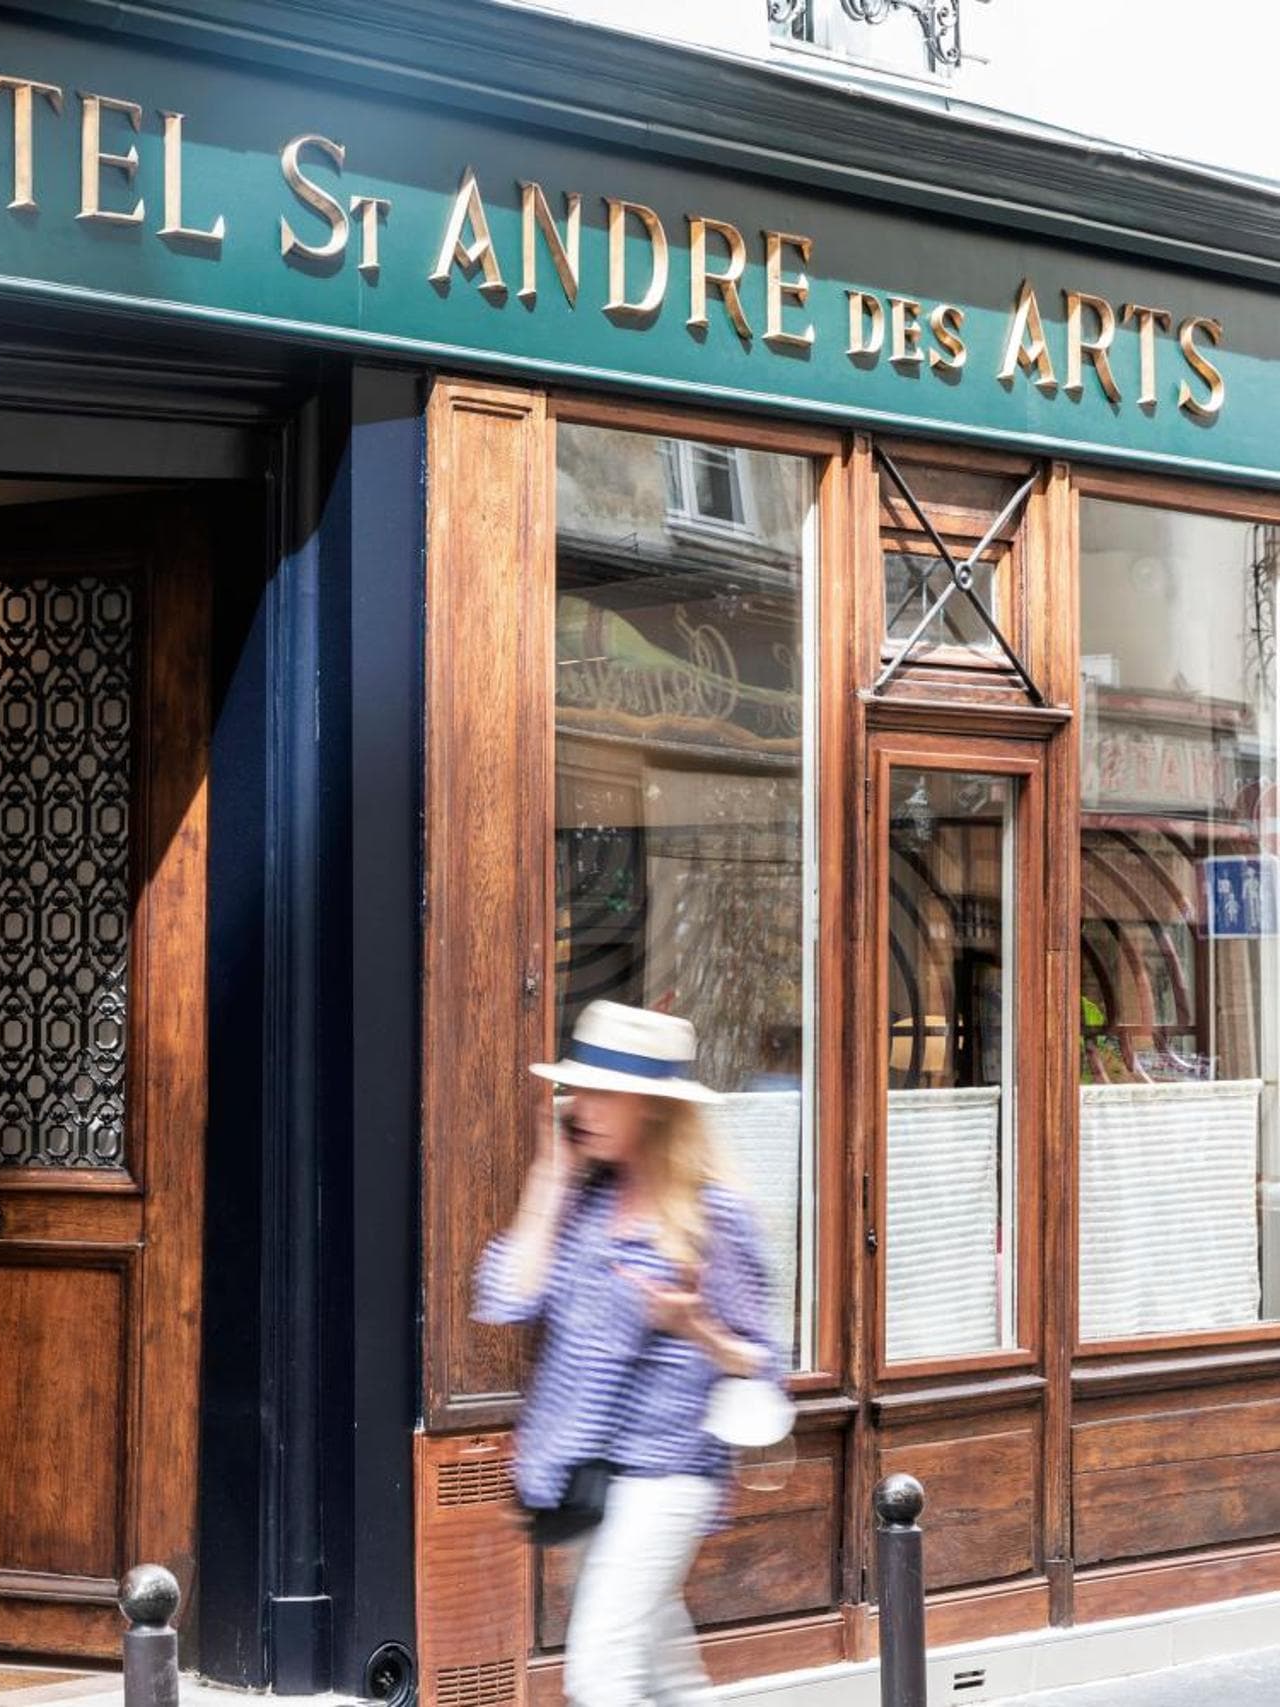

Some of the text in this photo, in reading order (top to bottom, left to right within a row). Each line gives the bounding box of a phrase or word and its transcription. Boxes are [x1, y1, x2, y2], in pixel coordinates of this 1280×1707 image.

[428, 164, 816, 346] ANDRE
[844, 289, 968, 369] DES
[996, 277, 1225, 416] ARTS
